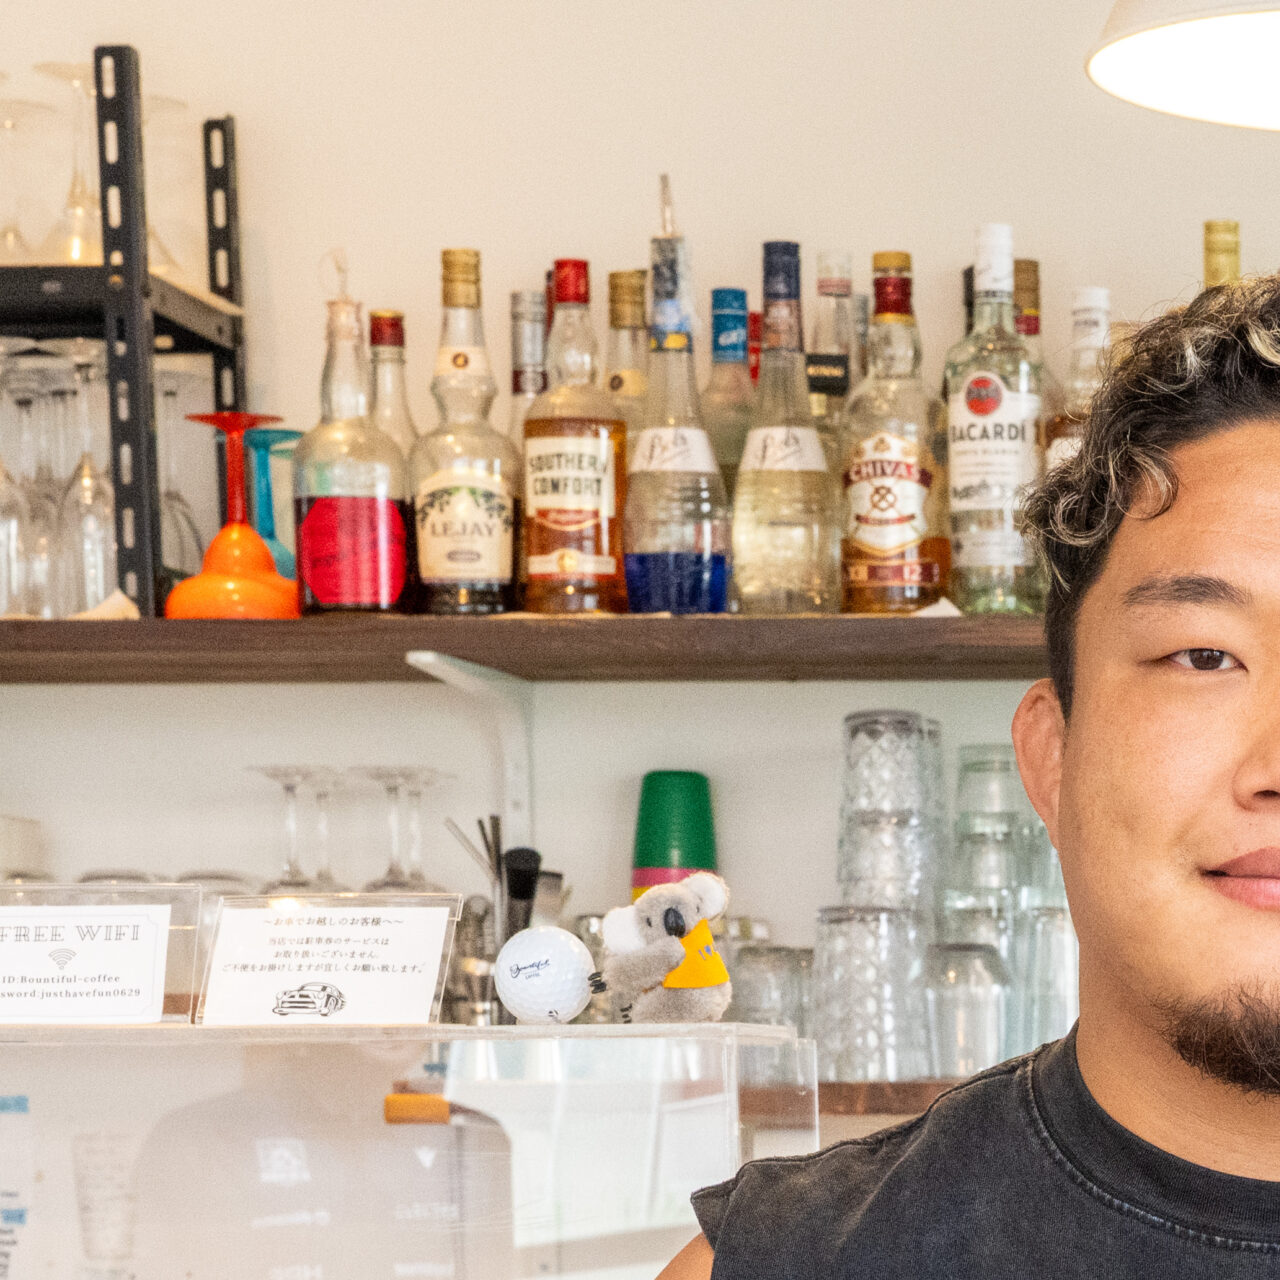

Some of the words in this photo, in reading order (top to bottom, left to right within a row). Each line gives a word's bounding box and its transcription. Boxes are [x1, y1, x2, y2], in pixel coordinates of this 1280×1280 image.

[528, 453, 608, 472] SOUTHERN
[851, 460, 921, 482] CHIVAS
[532, 476, 603, 496] COMFORT
[431, 521, 496, 537] LEJAY
[0, 925, 65, 942] FREE
[75, 924, 141, 942] WIFI
